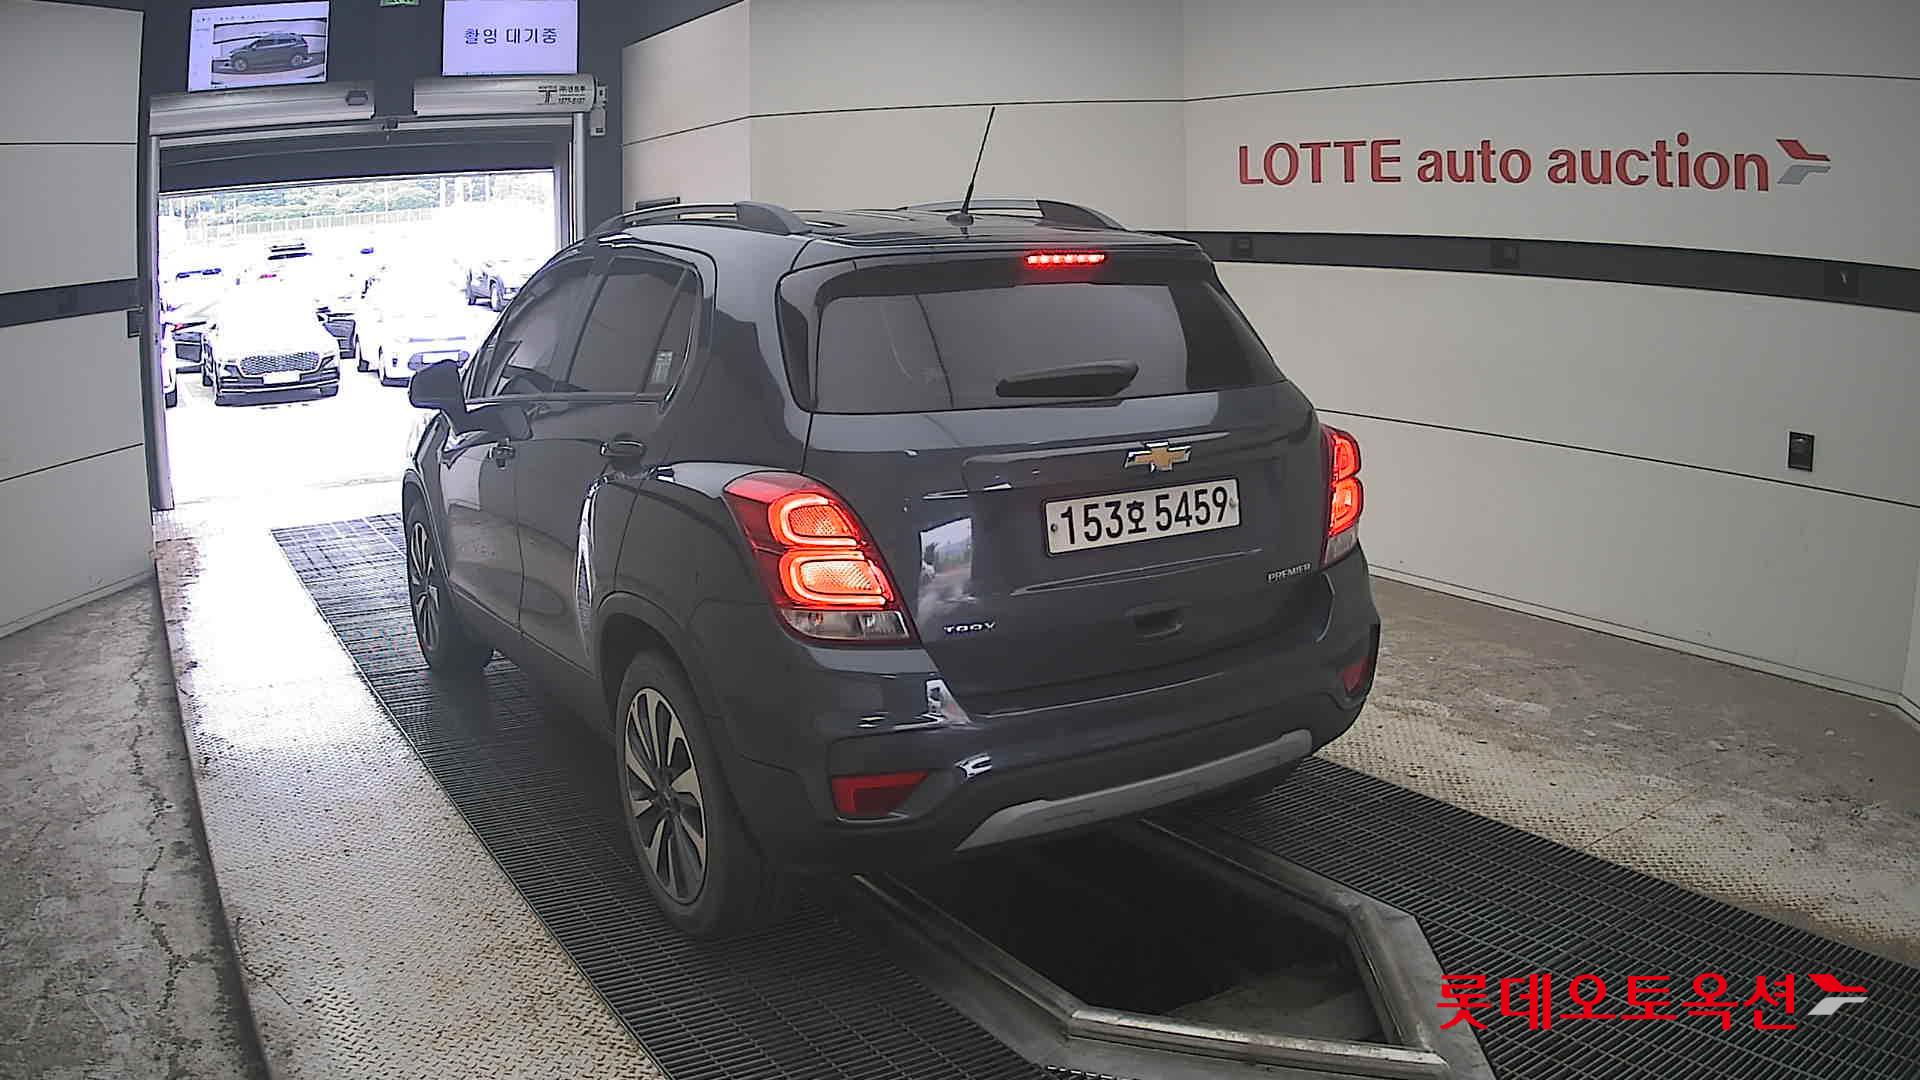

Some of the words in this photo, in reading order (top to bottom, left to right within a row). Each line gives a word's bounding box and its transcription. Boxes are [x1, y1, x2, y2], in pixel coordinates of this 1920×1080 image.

[506, 27, 557, 44] 대기중
[1240, 139, 1401, 185] LOTTE
[1417, 140, 1532, 184] auto
[1548, 132, 1769, 190] auction
